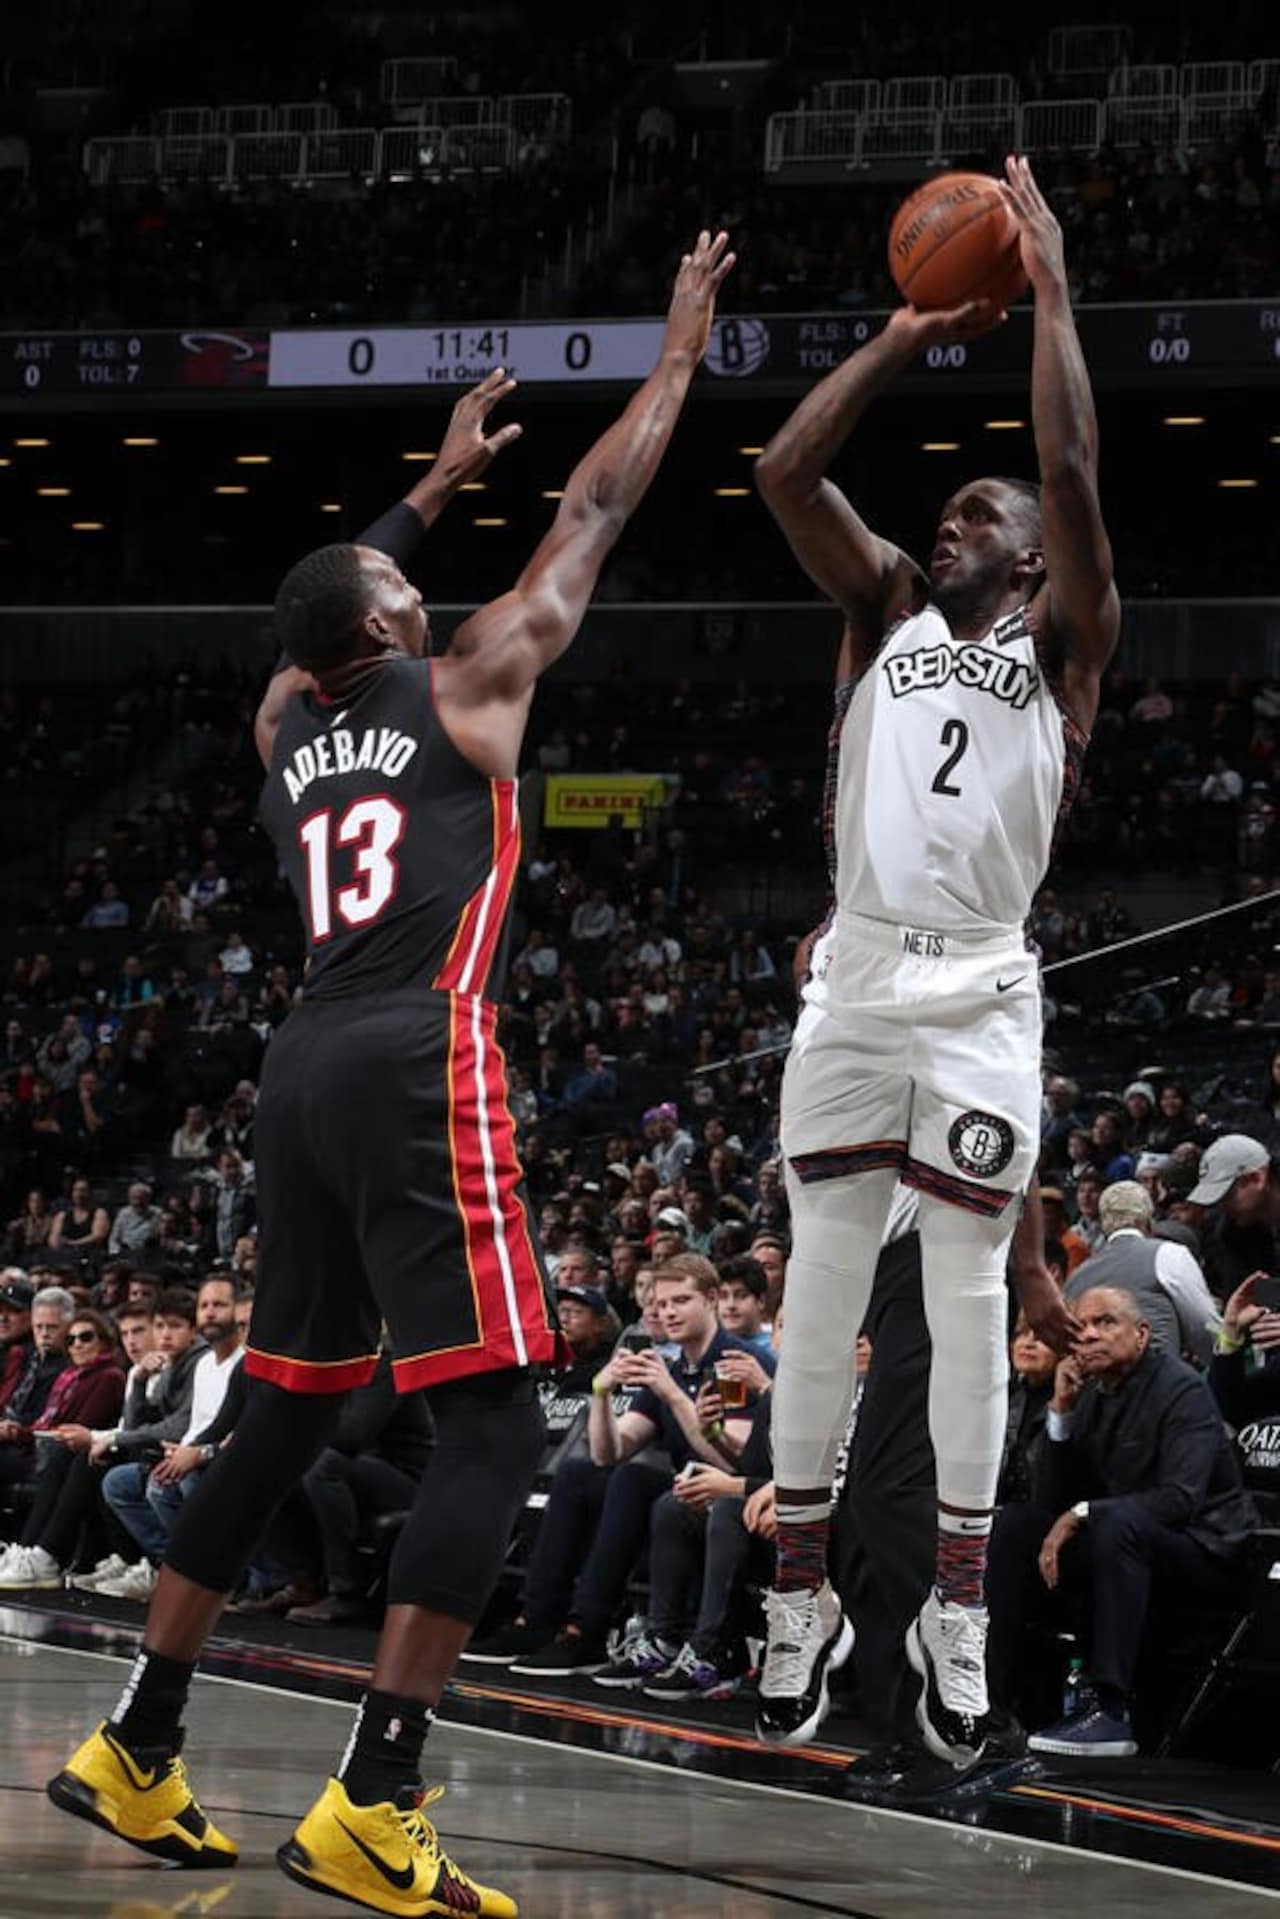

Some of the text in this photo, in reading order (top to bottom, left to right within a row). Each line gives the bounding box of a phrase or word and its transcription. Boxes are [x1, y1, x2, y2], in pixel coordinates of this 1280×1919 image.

[853, 320, 869, 341] 0
[1157, 312, 1185, 331] FT
[14, 341, 52, 359] AST
[127, 336, 141, 356] 0
[349, 338, 374, 375] 0
[434, 330, 509, 358] 11:41
[565, 333, 592, 370] 0
[926, 345, 967, 367] 0/0
[1149, 337, 1190, 362] 0/0
[24, 364, 40, 387] 0
[126, 364, 141, 383] 7
[883, 643, 1040, 710] BED-STUY
[282, 728, 418, 804] ADEBAYO
[930, 719, 968, 797] 2
[298, 793, 407, 945] 13
[903, 931, 944, 957] NETS
